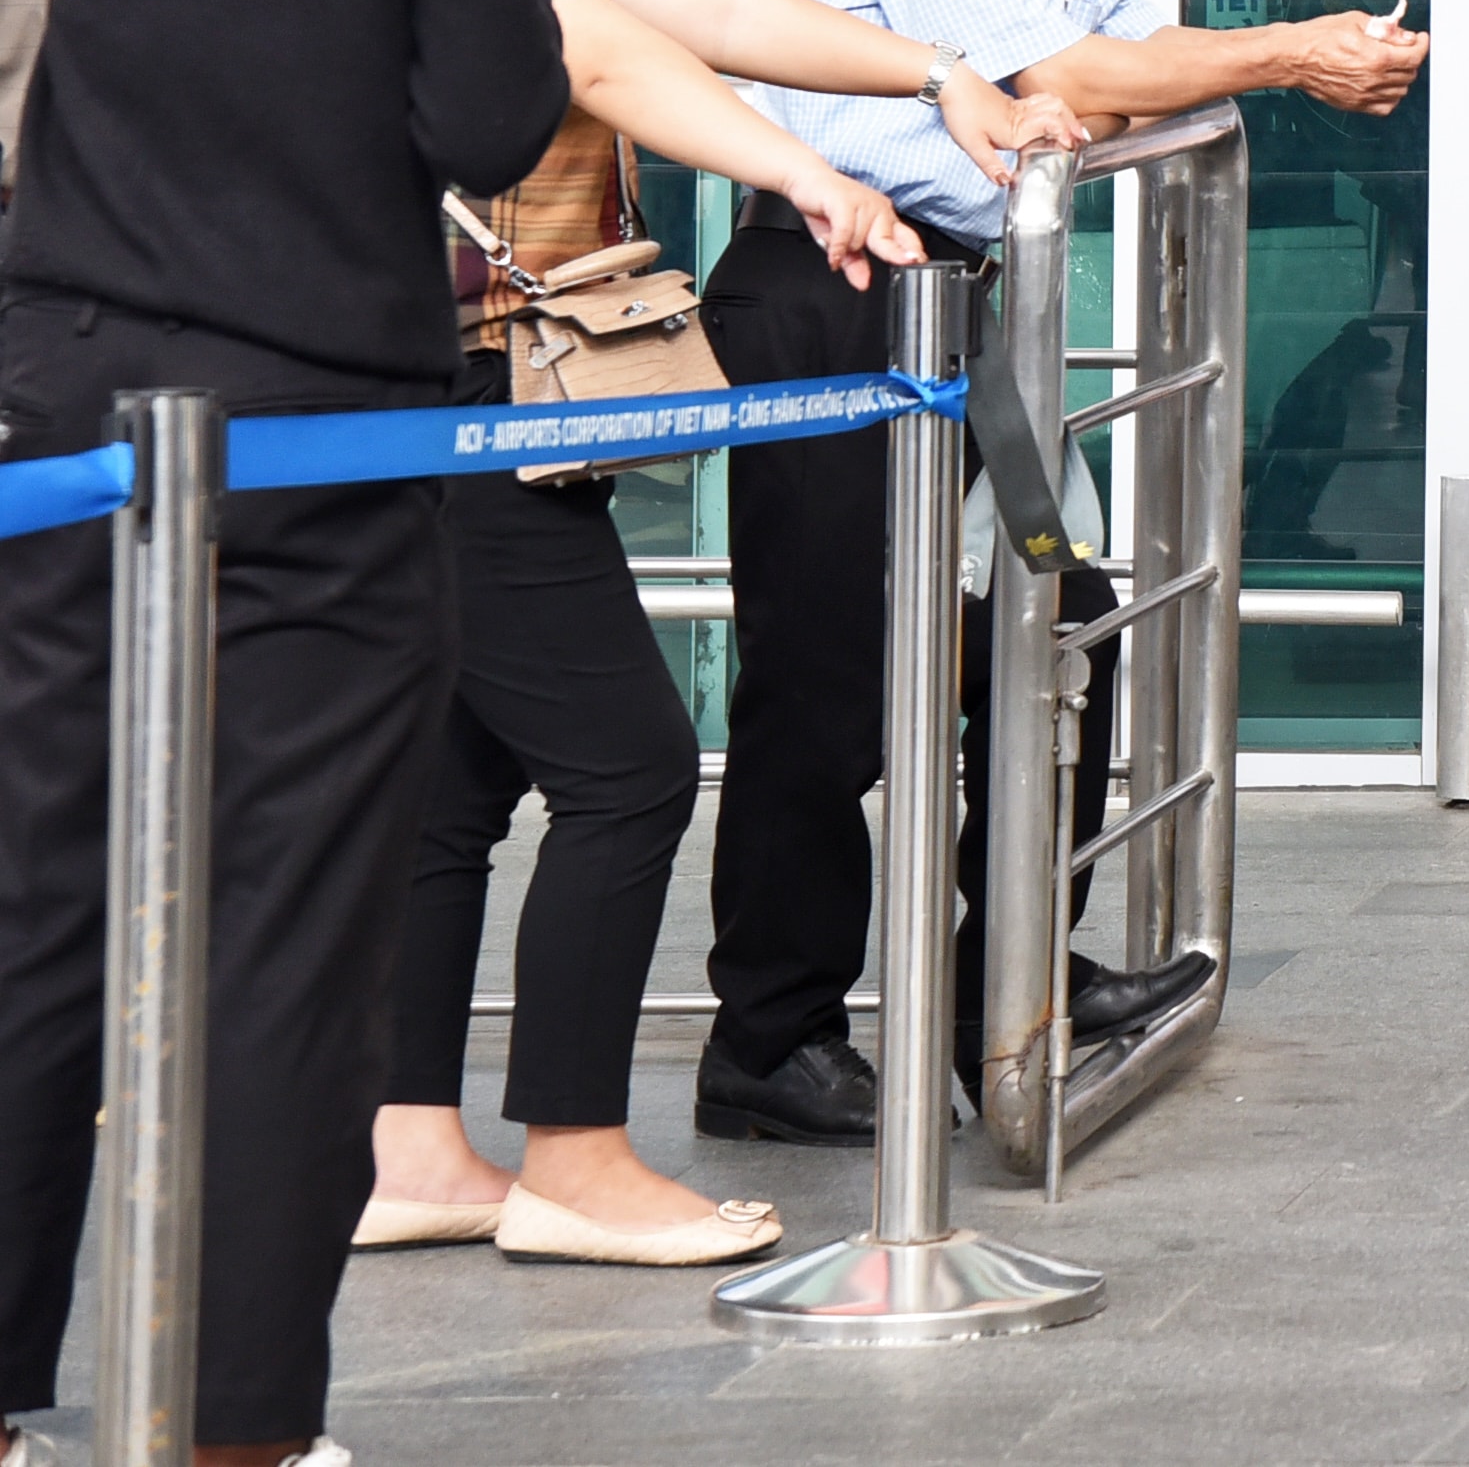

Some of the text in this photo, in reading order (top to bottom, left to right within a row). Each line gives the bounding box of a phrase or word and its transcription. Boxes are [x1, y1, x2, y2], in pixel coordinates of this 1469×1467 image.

[492, 416, 561, 452] AIRPORTS
[561, 410, 655, 446] CORPORATION
[655, 408, 673, 438] OF
[702, 402, 731, 432] NAM
